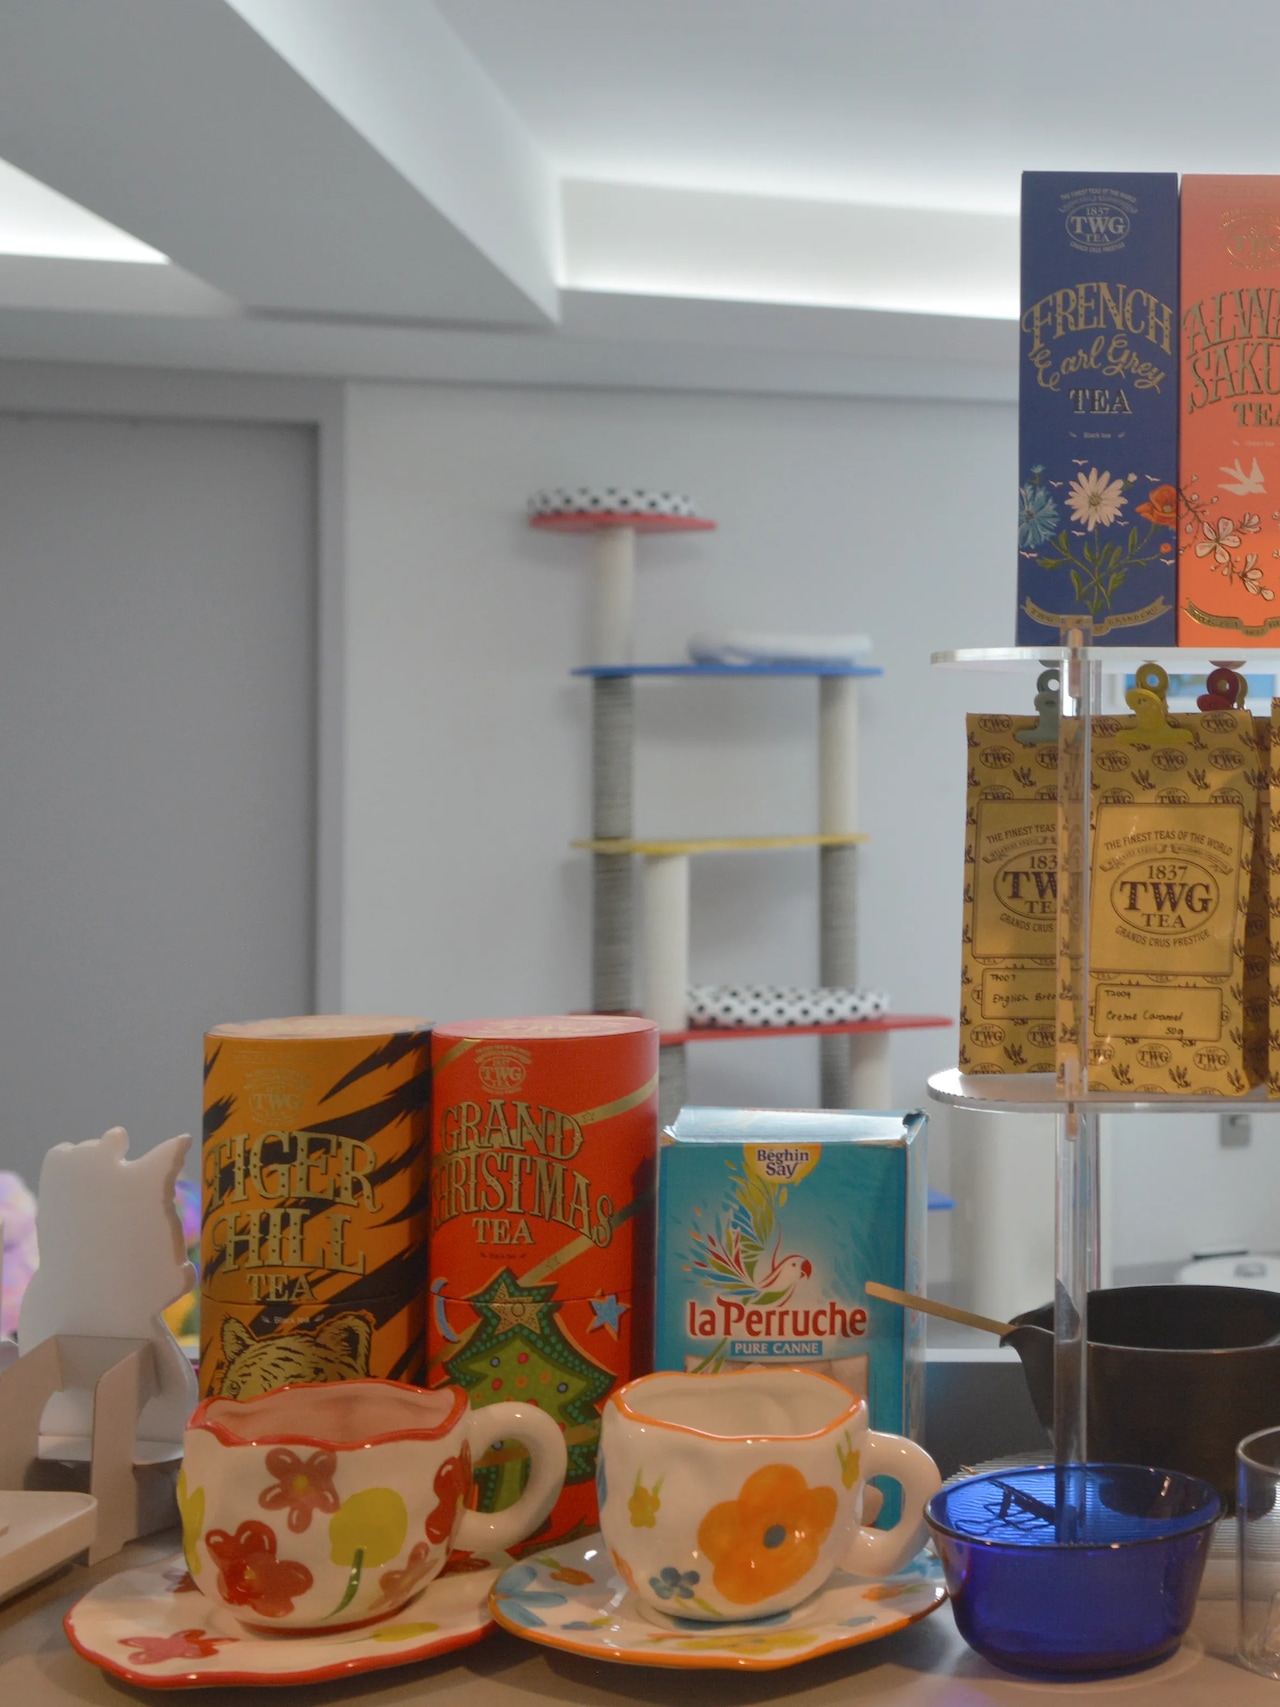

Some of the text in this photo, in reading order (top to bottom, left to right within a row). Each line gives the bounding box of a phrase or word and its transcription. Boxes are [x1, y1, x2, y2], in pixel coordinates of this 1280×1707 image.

[1086, 207, 1110, 216] 1837
[1070, 216, 1126, 234] TWG
[1085, 234, 1111, 242] TEA
[1021, 281, 1173, 358] FRENCH
[1034, 334, 1166, 394] Earl Grey
[1068, 388, 1133, 414] TEA
[1204, 718, 1236, 730] TWG
[982, 754, 1014, 762] TWG
[1100, 754, 1244, 766] TWG TWG TWG
[986, 824, 1056, 844] THE FINEST TEAS
[1104, 840, 1121, 852] THE
[1122, 832, 1152, 846] FINEST
[1154, 830, 1176, 840] TEAS
[1178, 830, 1190, 840] OF
[1190, 832, 1206, 845] THE
[1206, 836, 1233, 857] WORLD
[1030, 856, 1058, 870] 183
[1148, 864, 1188, 880] 1837
[1002, 871, 1058, 899] TW
[1119, 881, 1213, 913] TWG
[1024, 901, 1058, 914] TE
[1000, 913, 1054, 933] GRANDS CRUS
[1141, 913, 1186, 928] TEA
[1115, 925, 1210, 948] GRANDS CRUS PRESTIGE
[1142, 1009, 1184, 1022] Caramel
[974, 1031, 1004, 1041] TWG
[1139, 1050, 1228, 1066] TWG TWG
[481, 1066, 522, 1081] TWG
[440, 1098, 584, 1162] GRAND
[756, 1148, 810, 1165] Béghin
[205, 1128, 384, 1214] TIGER
[765, 1161, 798, 1179] Say
[432, 1151, 614, 1249] HRISTMAS
[472, 1217, 536, 1245] TEA
[211, 1207, 366, 1276] HILL
[245, 1272, 317, 1302] TEA
[734, 1342, 819, 1354] PURE CANNE
